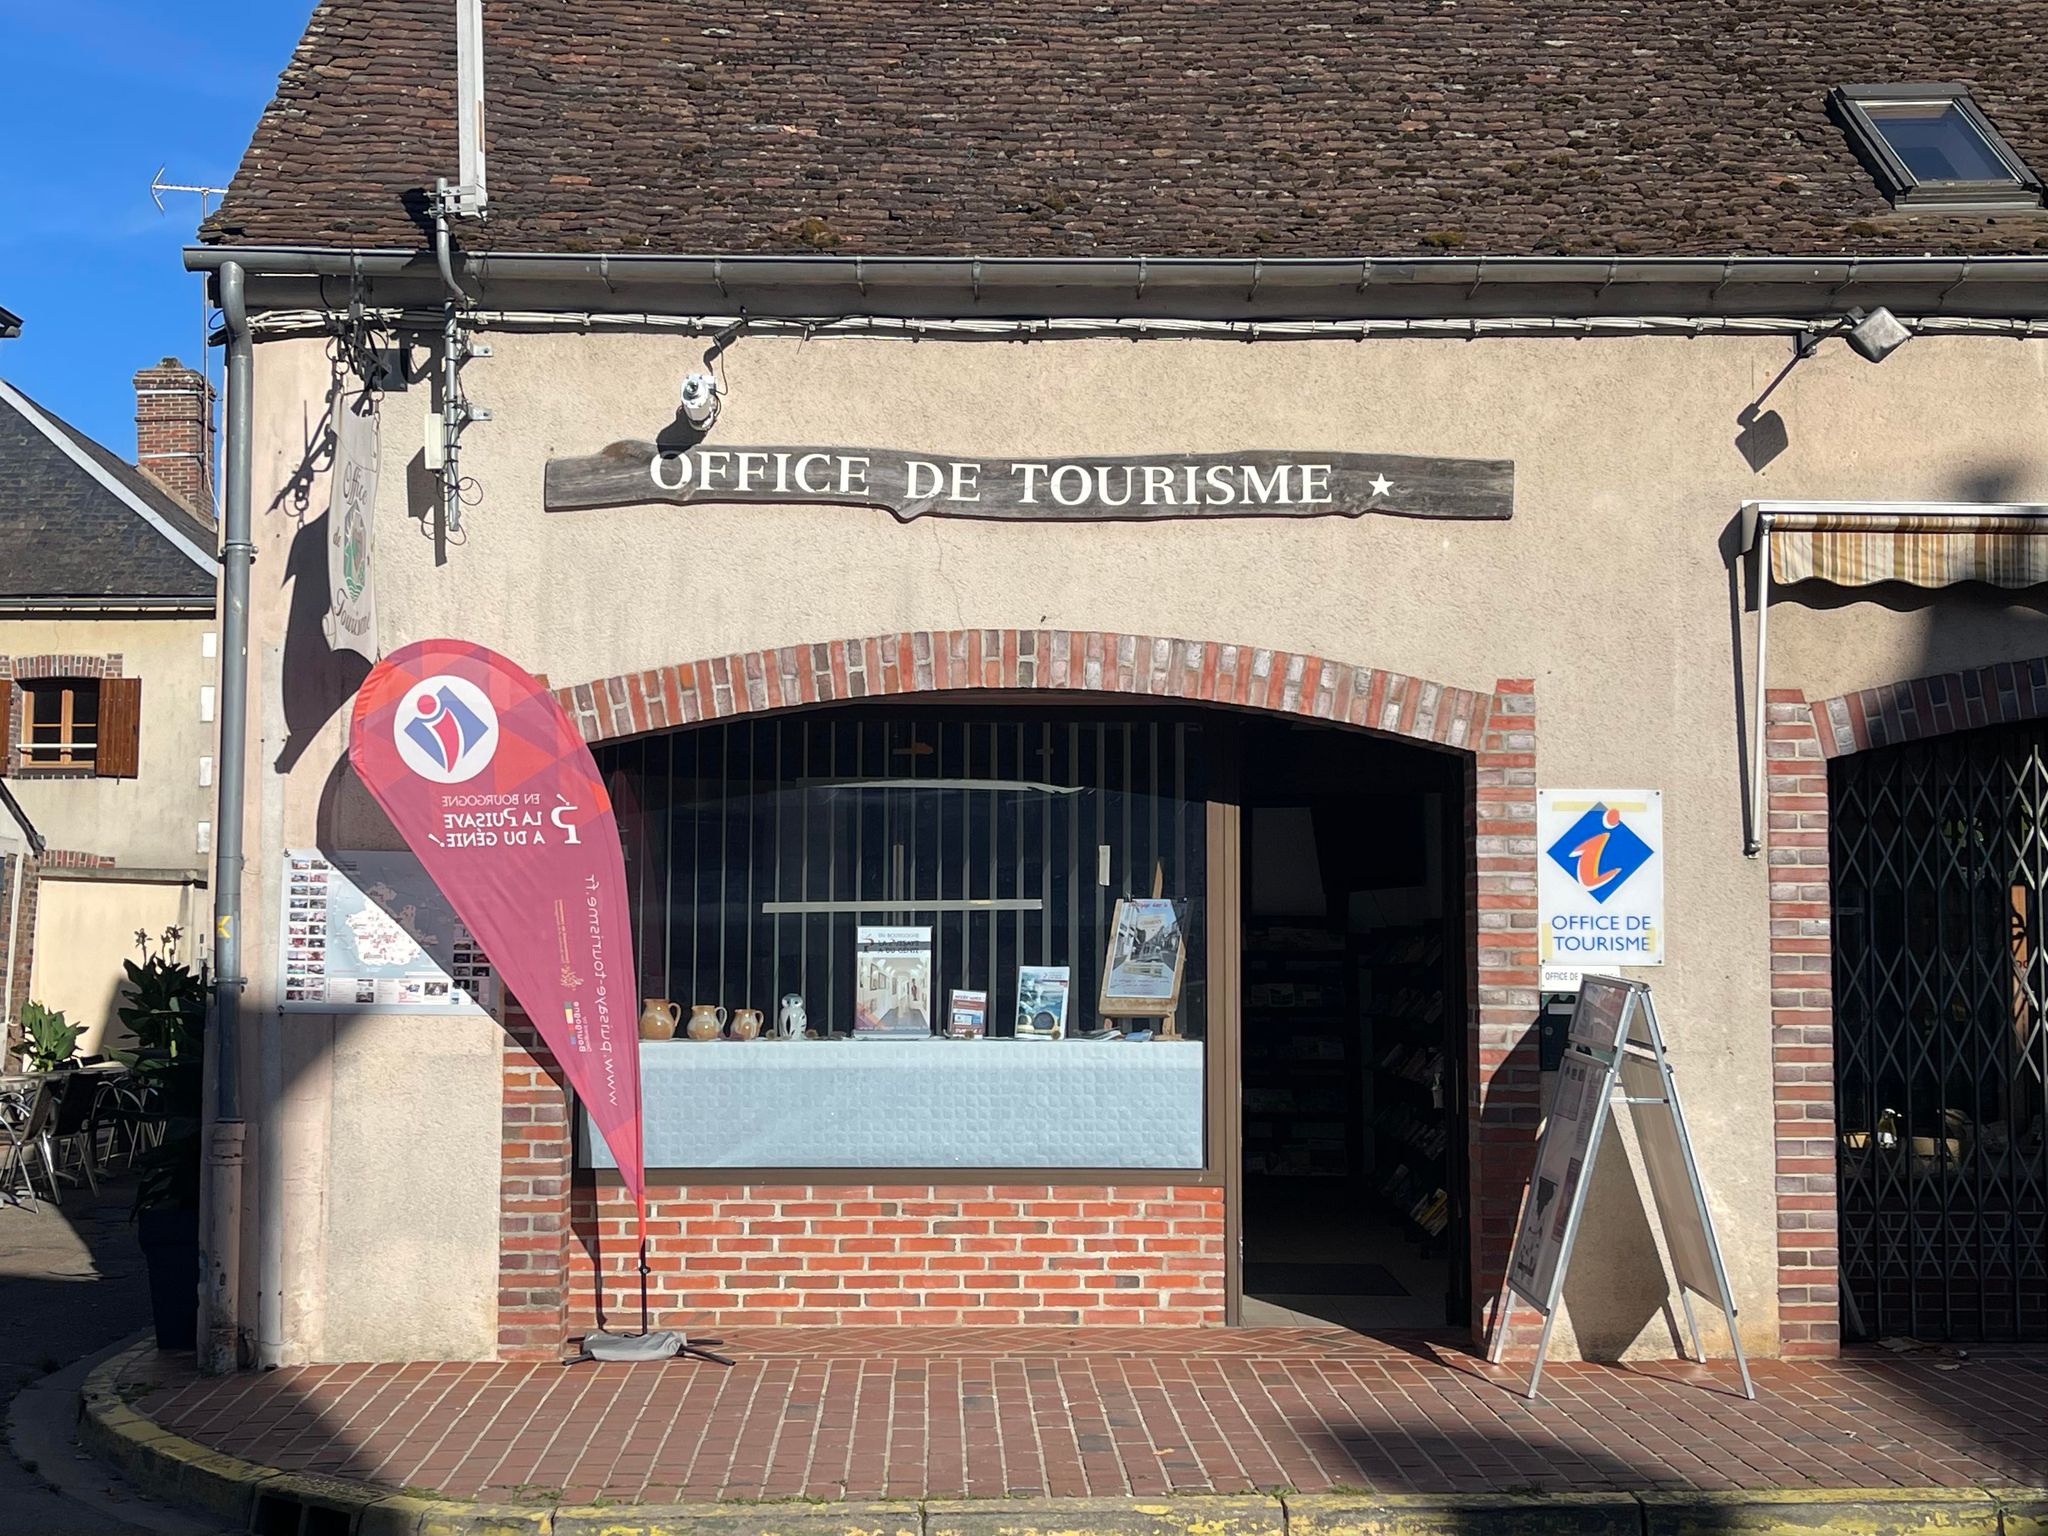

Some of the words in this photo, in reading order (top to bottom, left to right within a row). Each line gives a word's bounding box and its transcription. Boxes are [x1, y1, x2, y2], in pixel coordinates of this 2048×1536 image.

[650, 451, 870, 496] OFFICE
[904, 459, 981, 502] DE
[1011, 463, 1332, 506] TOURISME
[1552, 915, 1619, 931] OFFICE
[1626, 916, 1652, 930] DE
[1553, 936, 1651, 951] TOURISME
[1545, 972, 1568, 981] OFFICE
[1570, 972, 1579, 981] DE
